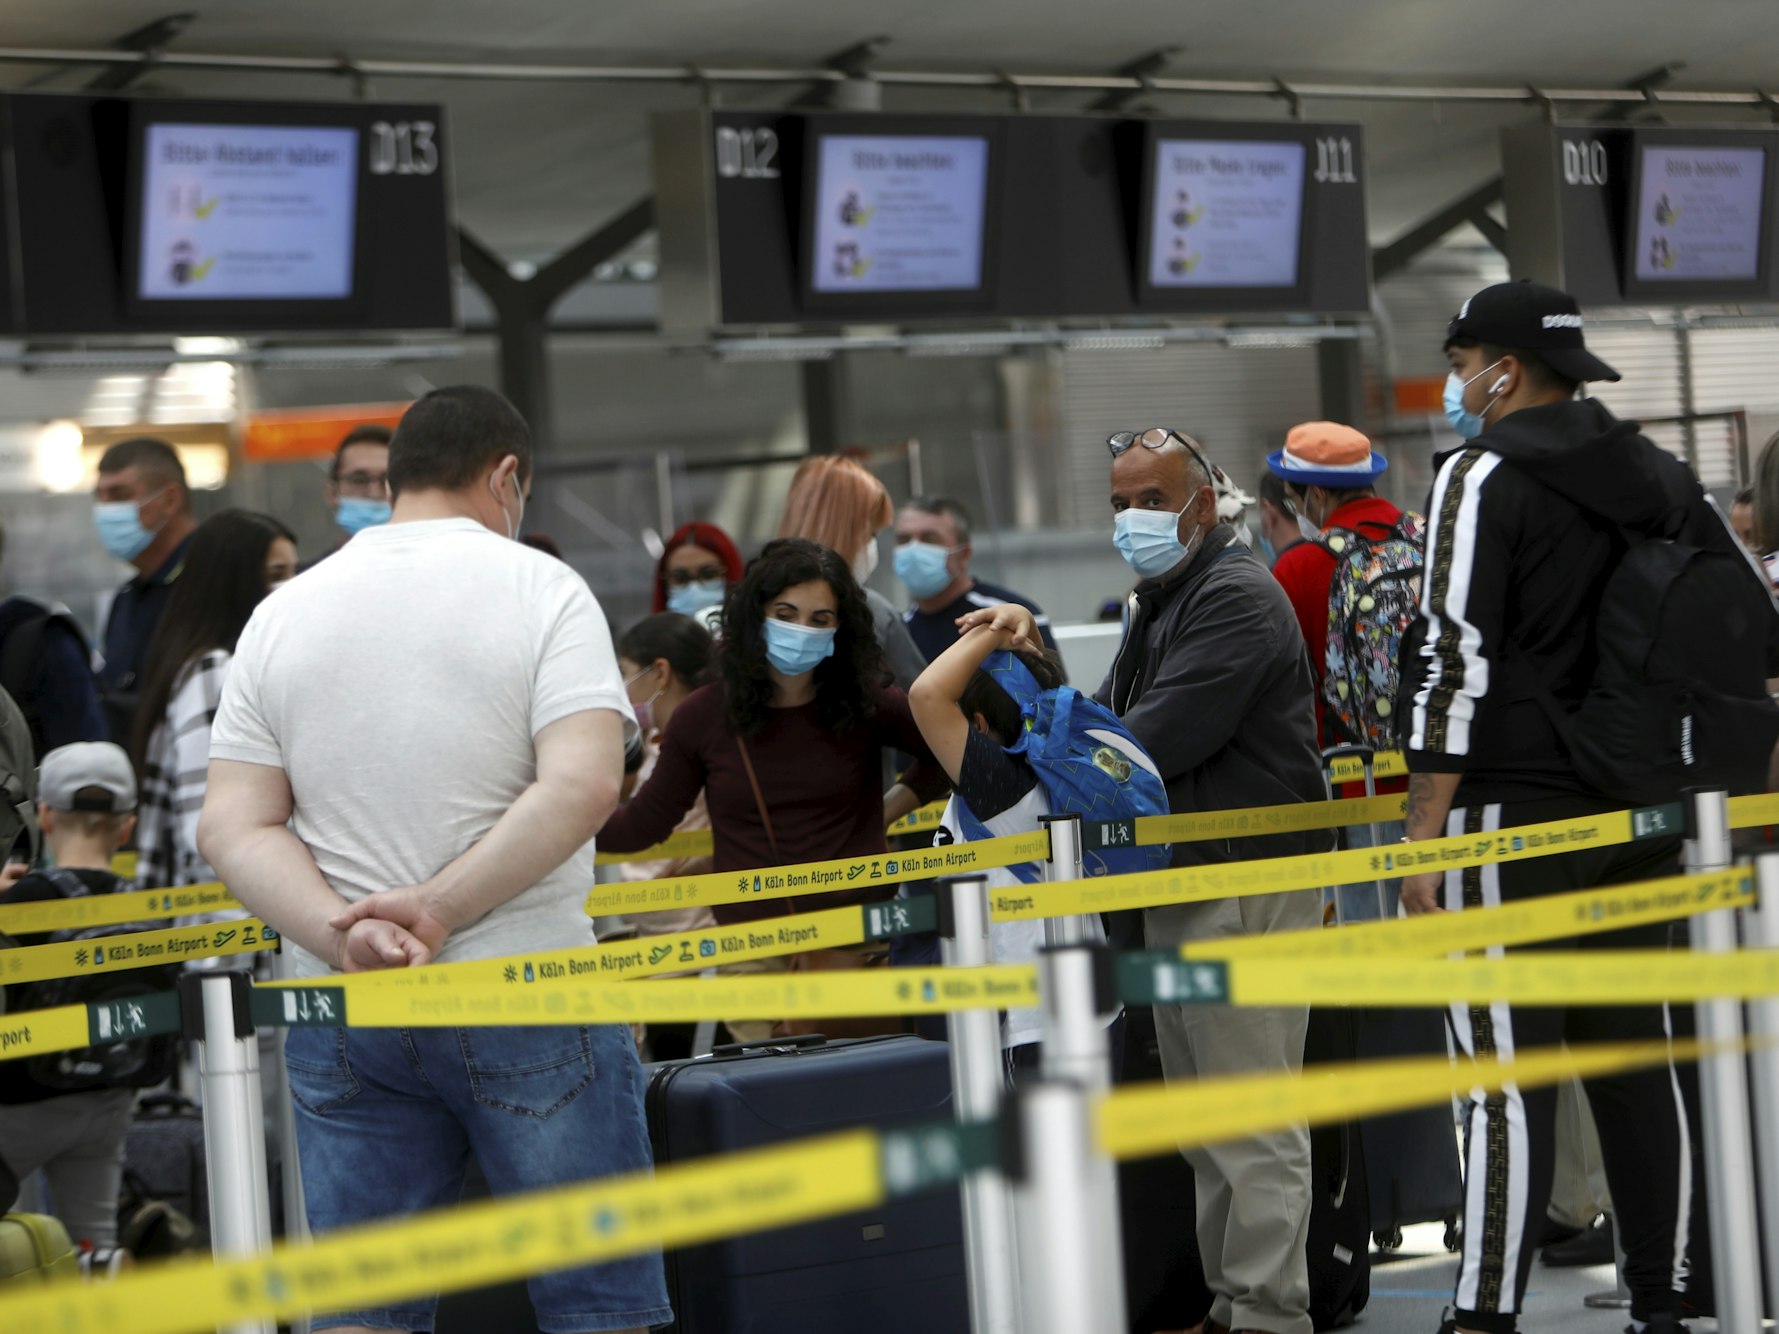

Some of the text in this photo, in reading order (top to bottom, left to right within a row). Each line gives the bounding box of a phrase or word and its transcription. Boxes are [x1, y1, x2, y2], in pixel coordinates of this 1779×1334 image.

[369, 121, 438, 175] D13
[714, 125, 779, 178] D12
[1563, 140, 1607, 185] D10
[1352, 762, 1364, 775] Bon
[902, 850, 977, 872] Köln Bonn Airport
[765, 869, 843, 889] Köln Bonn Airport
[997, 896, 1034, 914] Airport
[109, 936, 208, 962] Köln Bonn Airport
[721, 925, 818, 953] Köln Bonn Airport
[539, 952, 643, 979] Köln Bonn Airport
